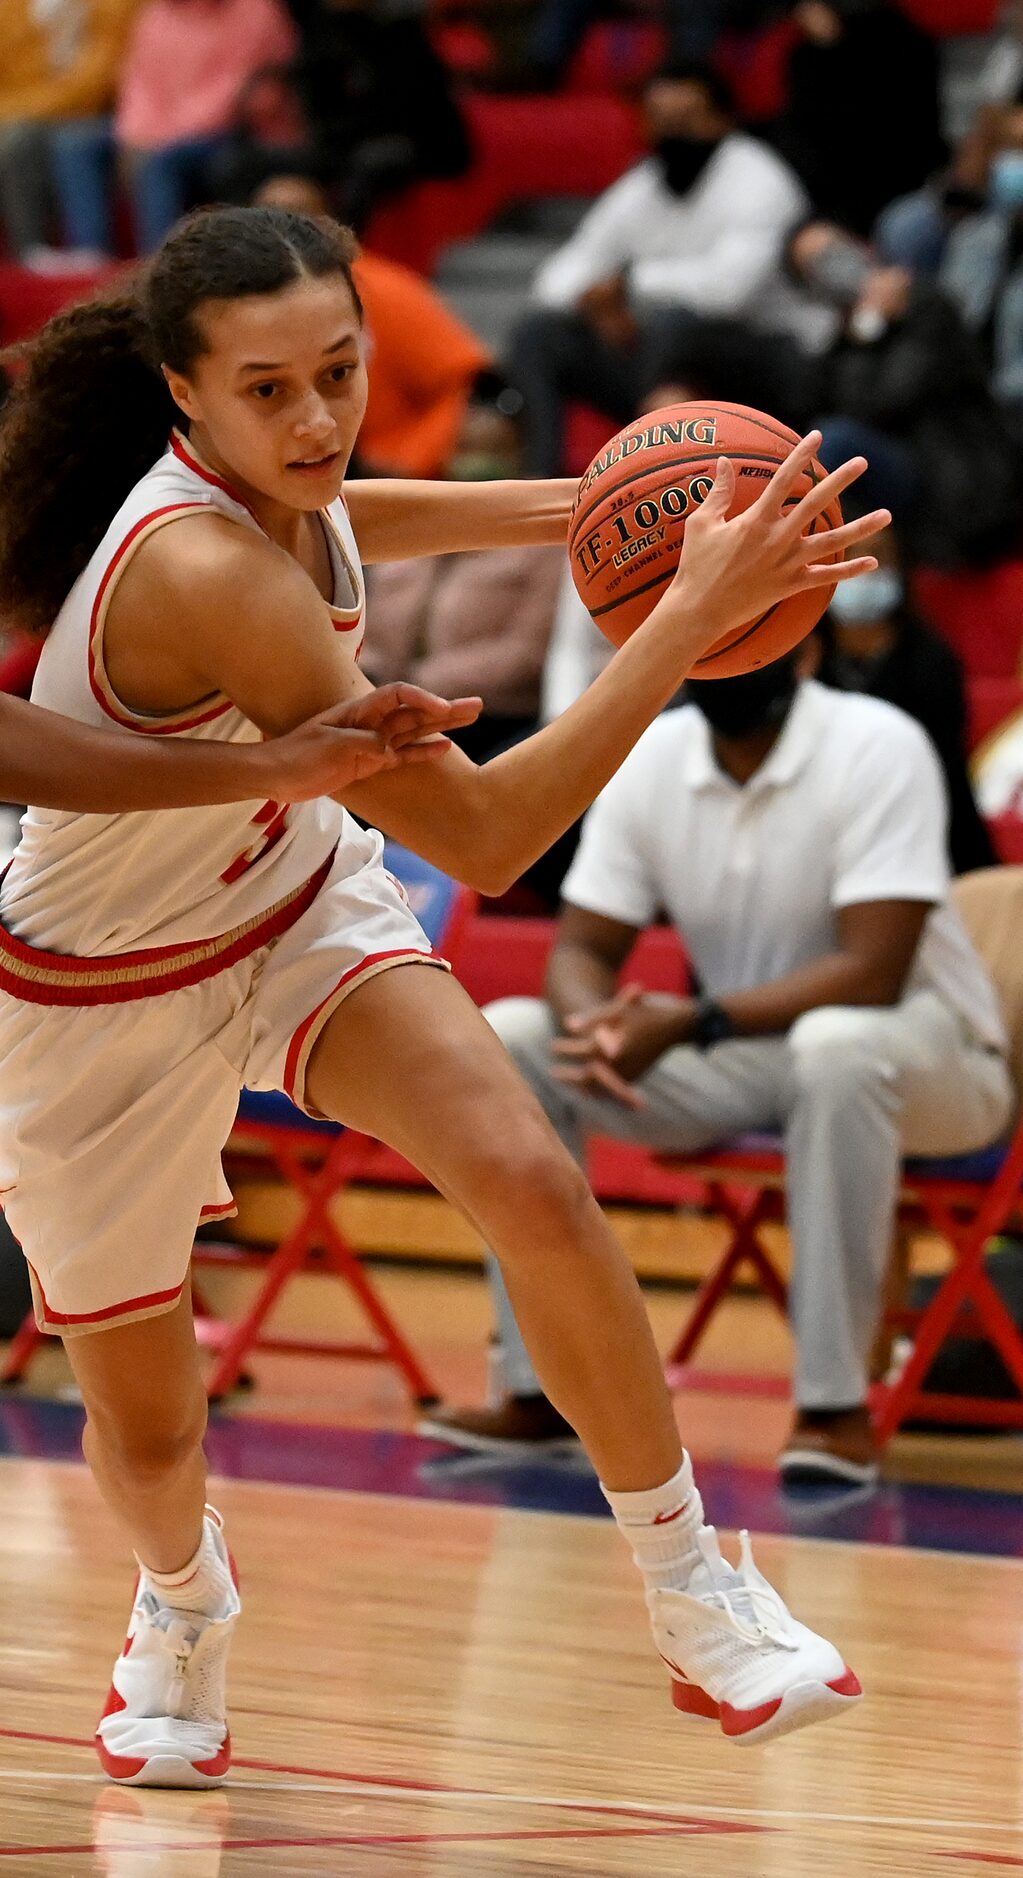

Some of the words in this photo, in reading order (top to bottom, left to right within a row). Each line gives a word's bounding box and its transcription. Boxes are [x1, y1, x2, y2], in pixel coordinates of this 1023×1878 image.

[569, 417, 717, 524] PALDING
[576, 476, 715, 578] TF-1000
[612, 525, 667, 569] LEGACY
[623, 549, 664, 577] CHANNEL
